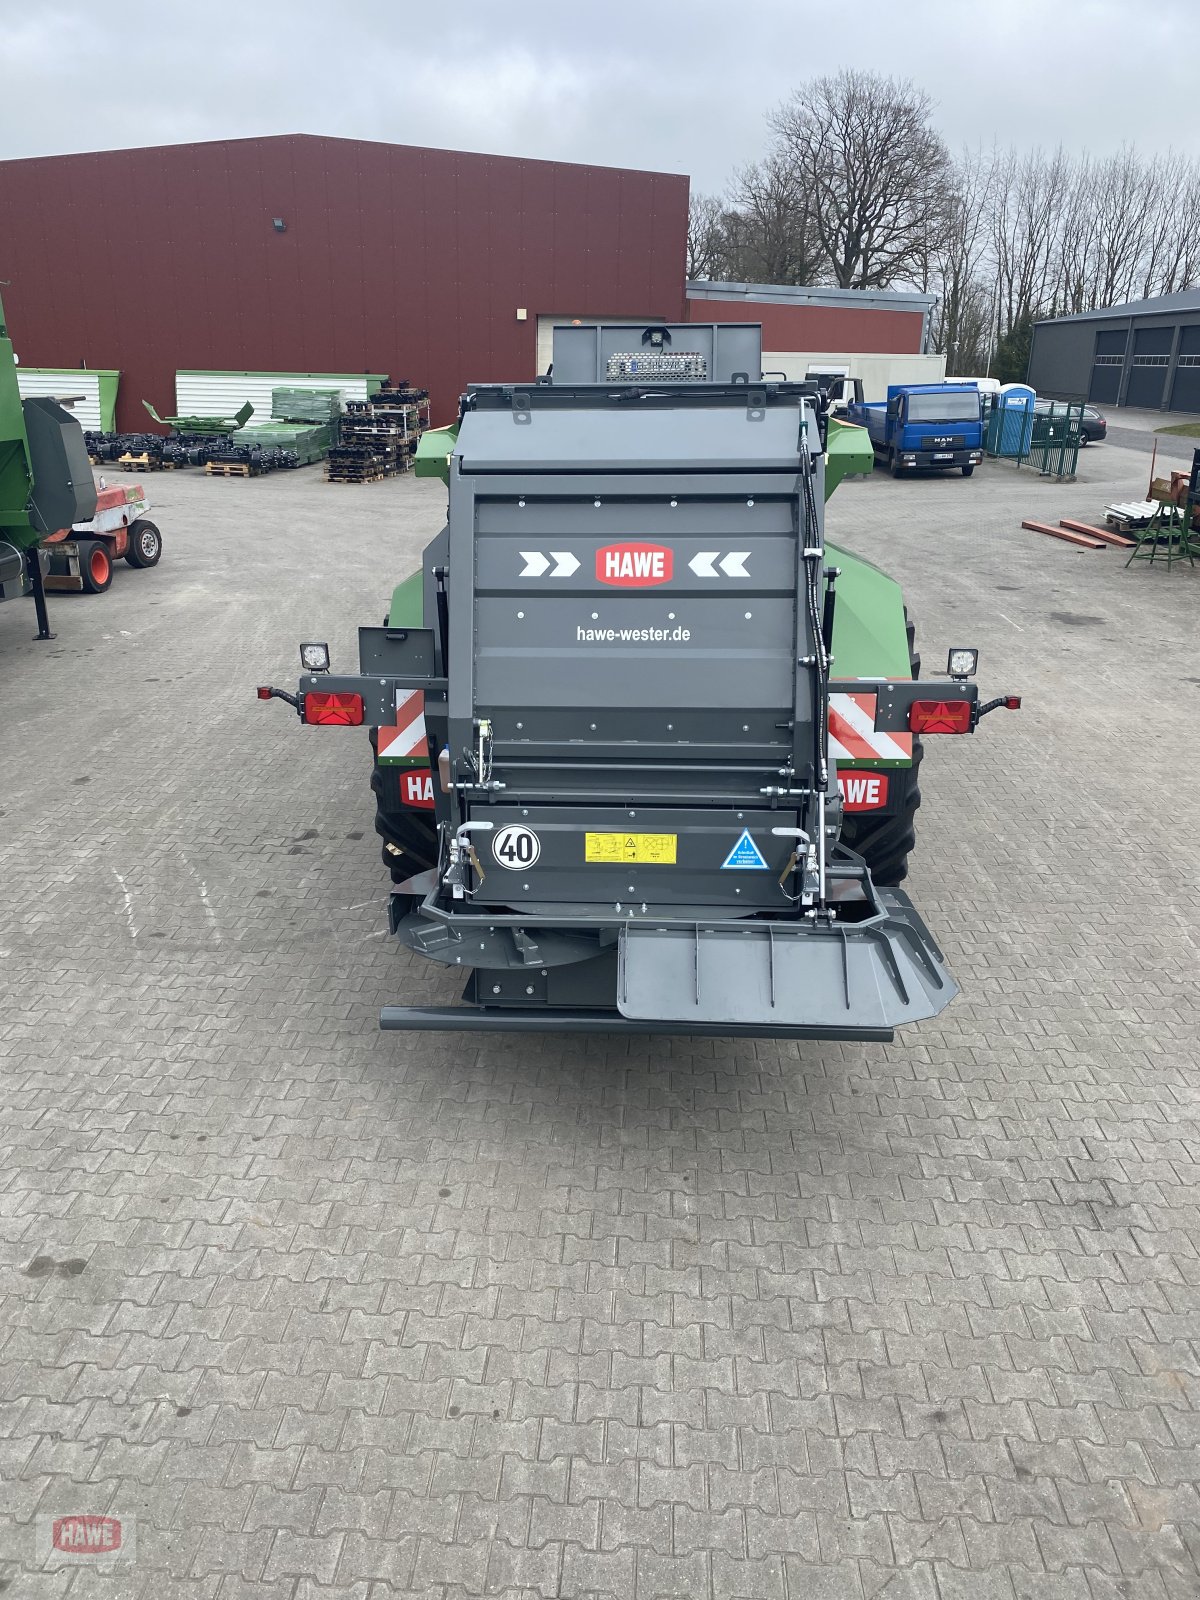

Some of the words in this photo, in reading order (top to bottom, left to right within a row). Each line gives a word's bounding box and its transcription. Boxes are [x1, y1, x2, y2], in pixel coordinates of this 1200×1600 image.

[605, 551, 665, 578] HAWE
[576, 626, 691, 642] hawe-wester.de
[407, 776, 434, 801] HA
[838, 779, 881, 804] AWE
[499, 833, 533, 863] 40
